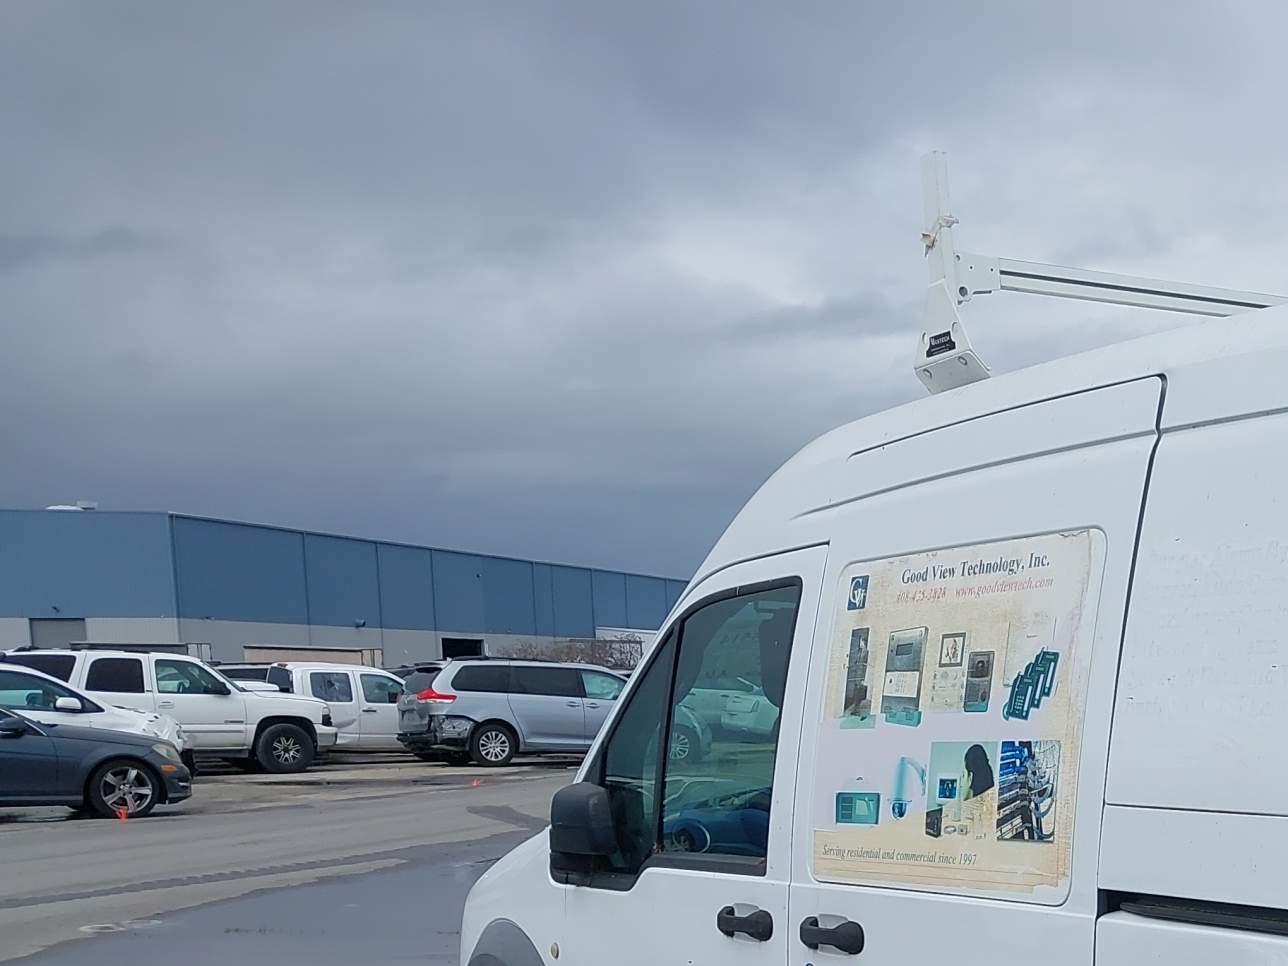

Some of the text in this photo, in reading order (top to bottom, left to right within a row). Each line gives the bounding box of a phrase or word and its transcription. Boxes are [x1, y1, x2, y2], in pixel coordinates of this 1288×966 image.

[902, 552, 1051, 584] Good View Technology, Inc.
[822, 844, 977, 866] Serving residential and commercial since 1997
